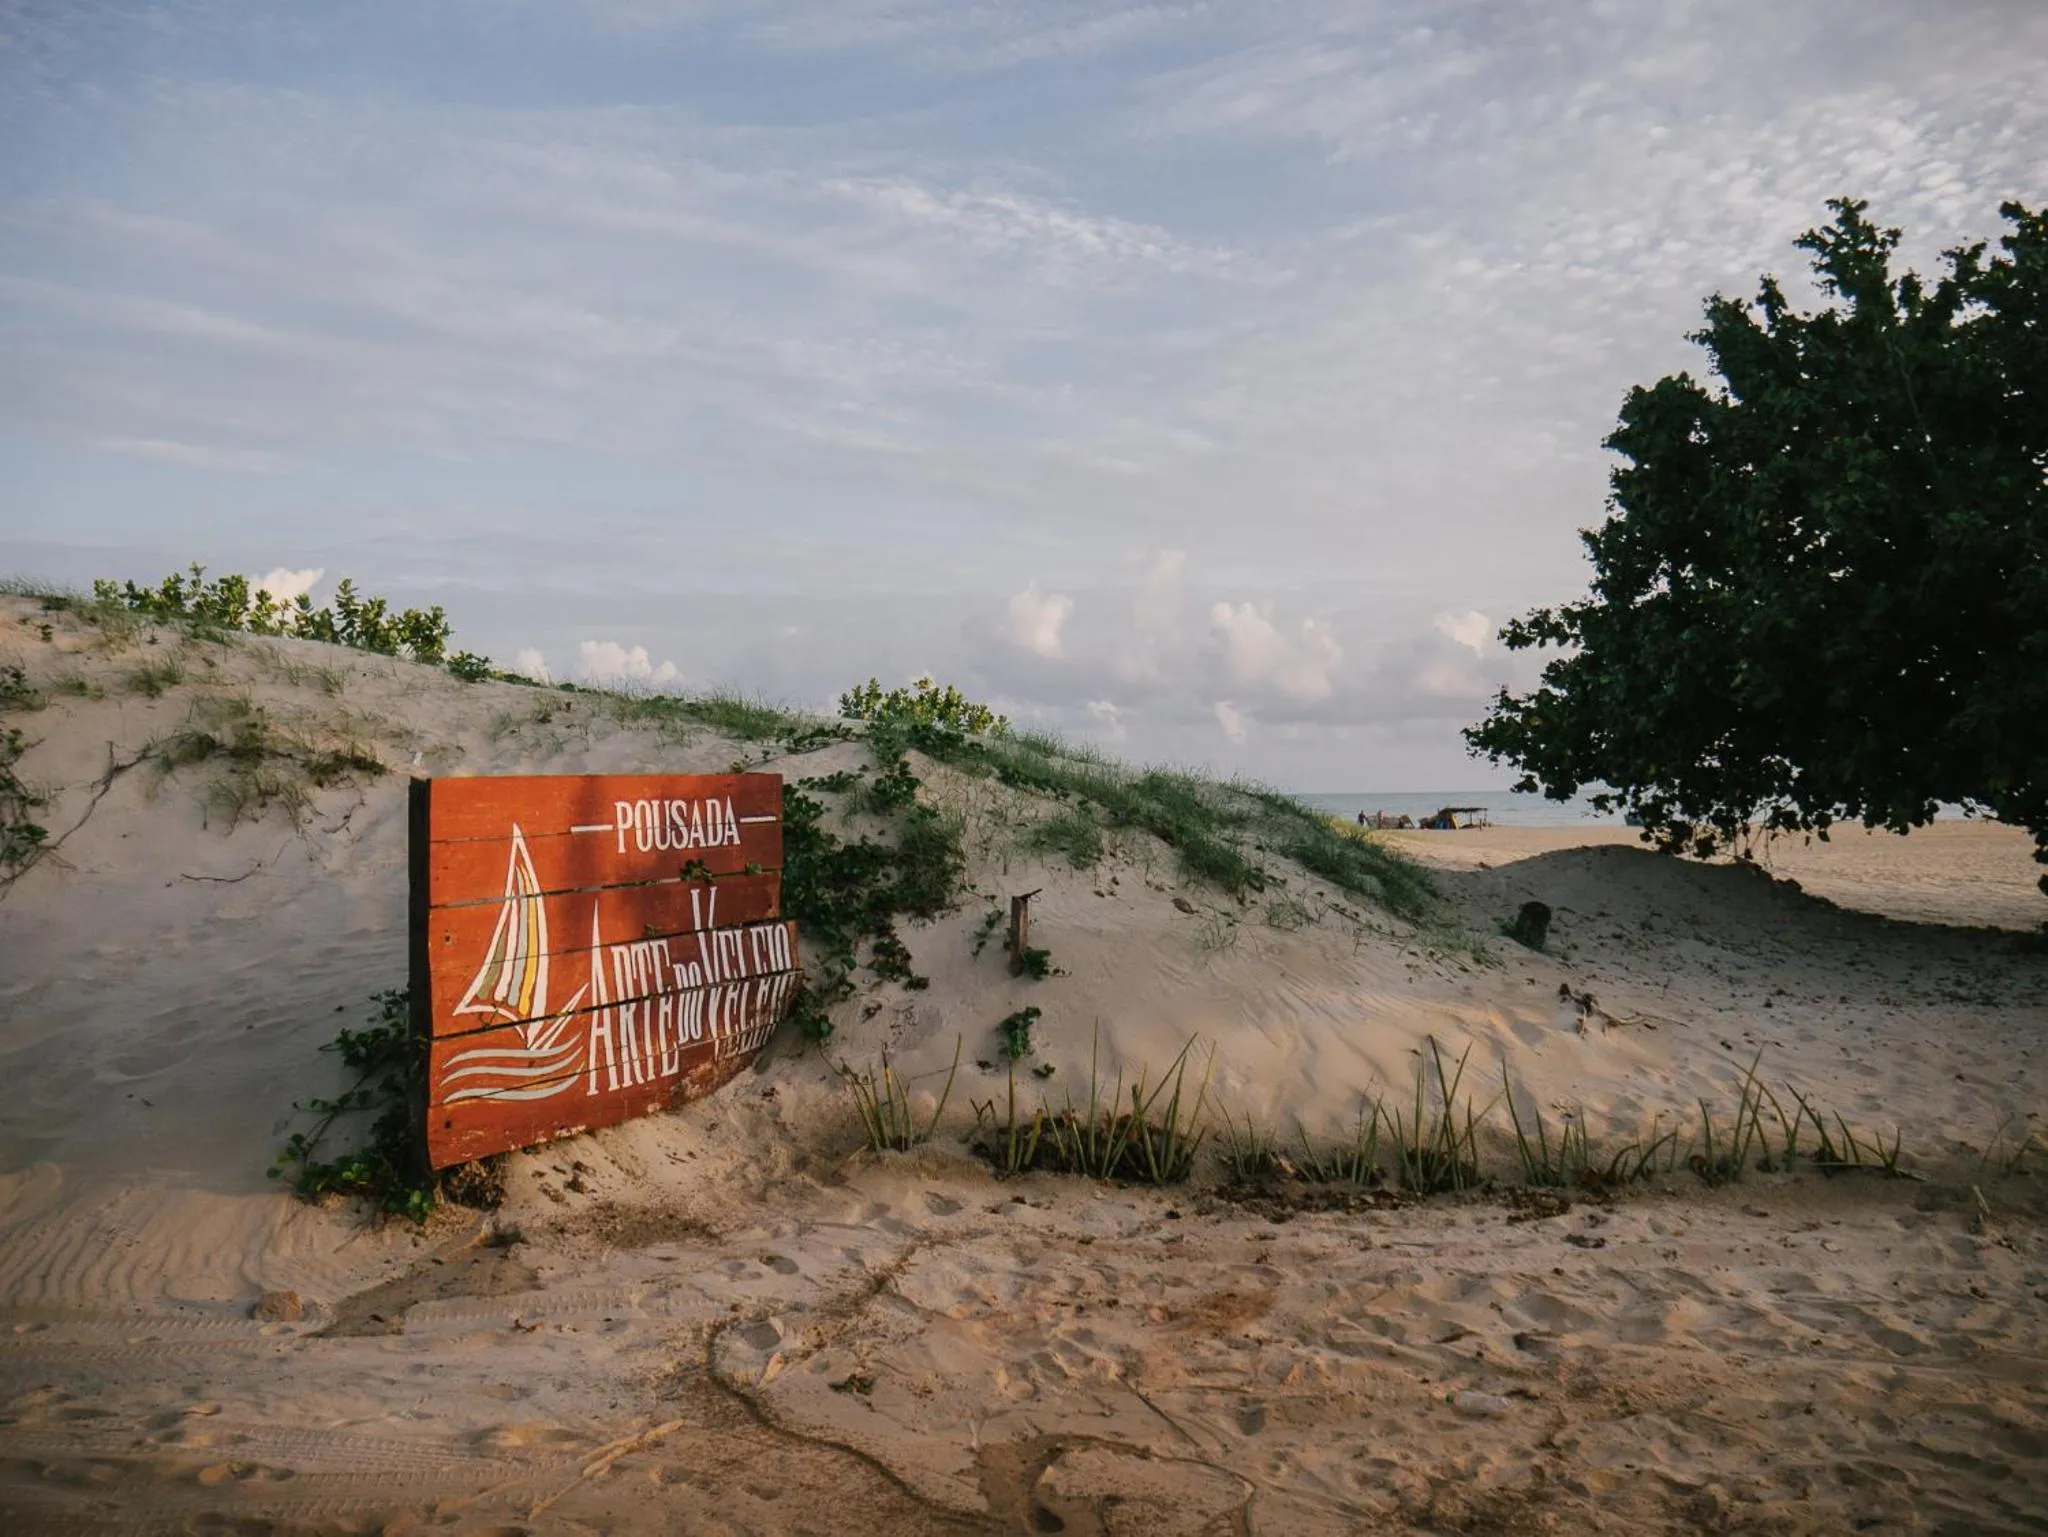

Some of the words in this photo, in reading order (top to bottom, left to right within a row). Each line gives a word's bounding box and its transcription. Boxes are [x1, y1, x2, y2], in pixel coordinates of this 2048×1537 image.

[614, 796, 741, 853] POUSADA
[586, 899, 679, 1096] ARTE
[673, 961, 703, 1044] DO
